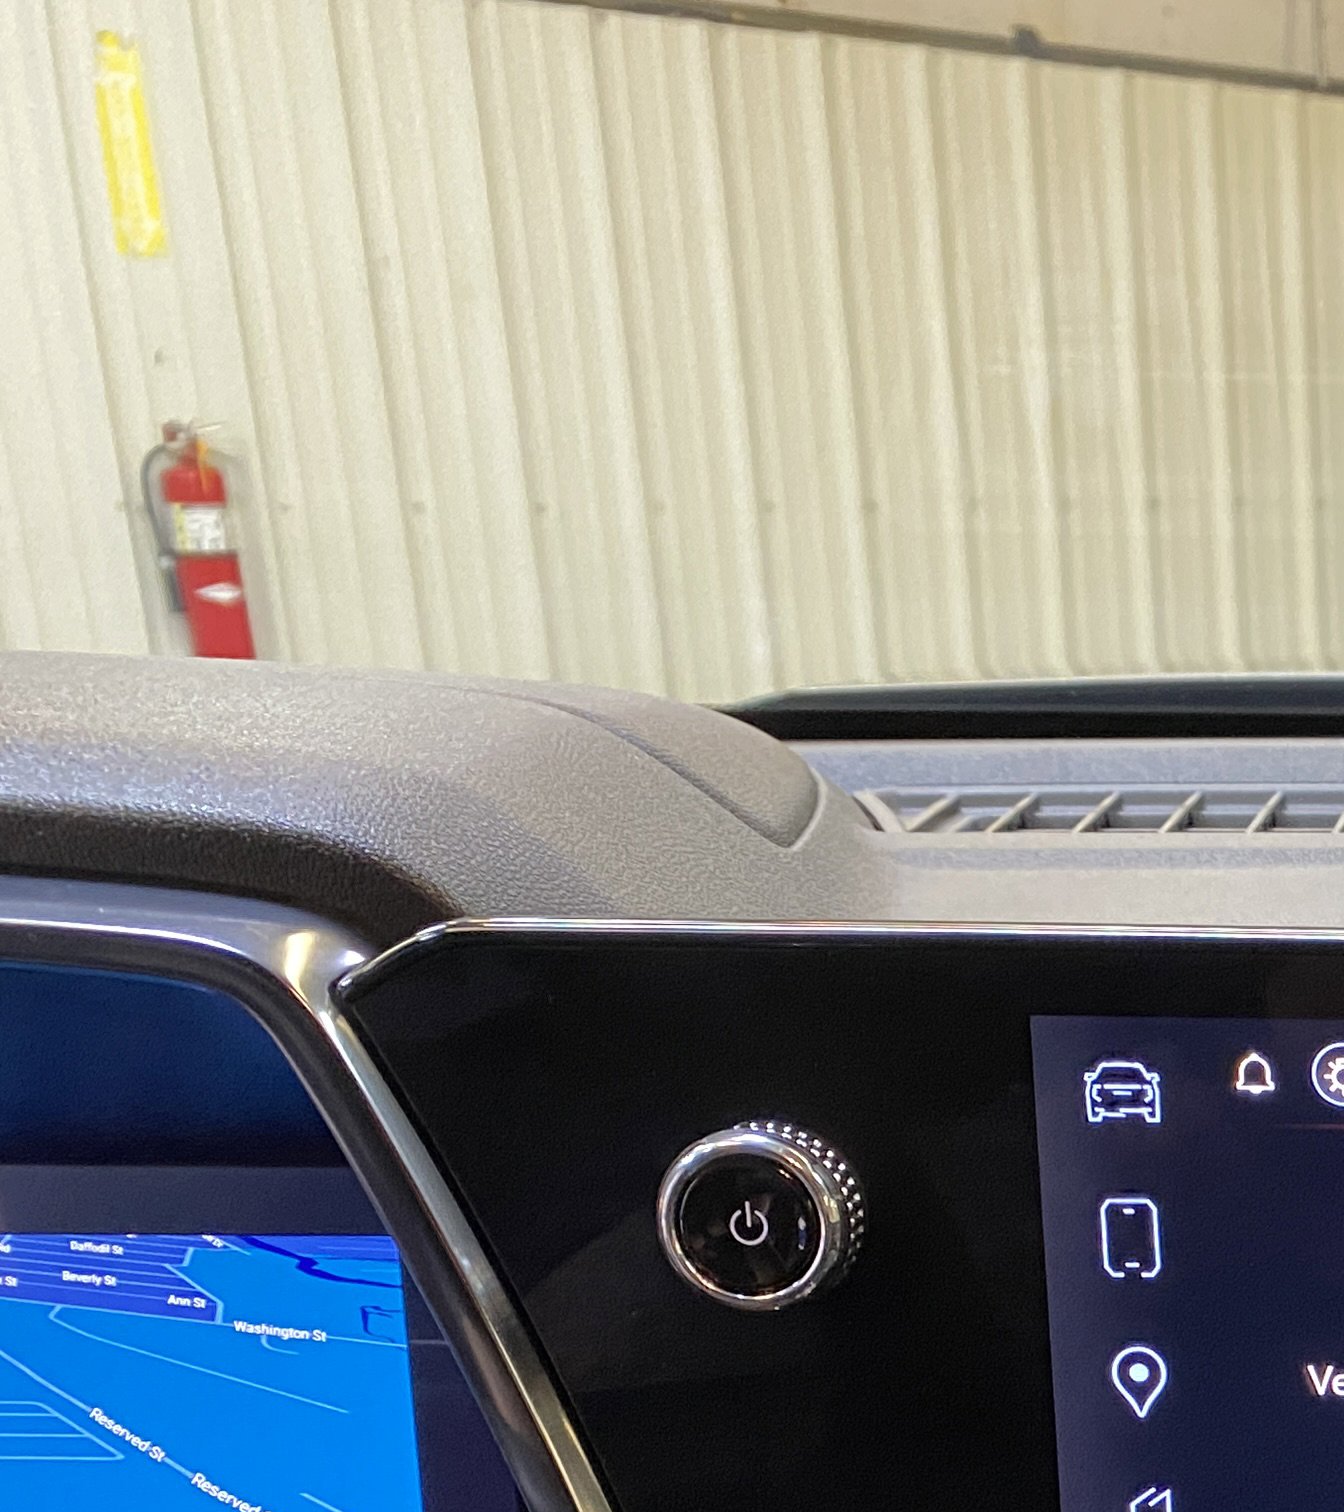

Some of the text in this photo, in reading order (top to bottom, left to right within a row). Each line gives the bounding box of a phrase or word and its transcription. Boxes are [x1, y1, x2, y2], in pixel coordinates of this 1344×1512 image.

[70, 1240, 124, 1255] Daffodil St
[62, 1270, 117, 1287] Beverly St
[167, 1294, 207, 1309] Ann St
[233, 1320, 327, 1342] Washington St
[89, 1407, 166, 1462] Reserved St
